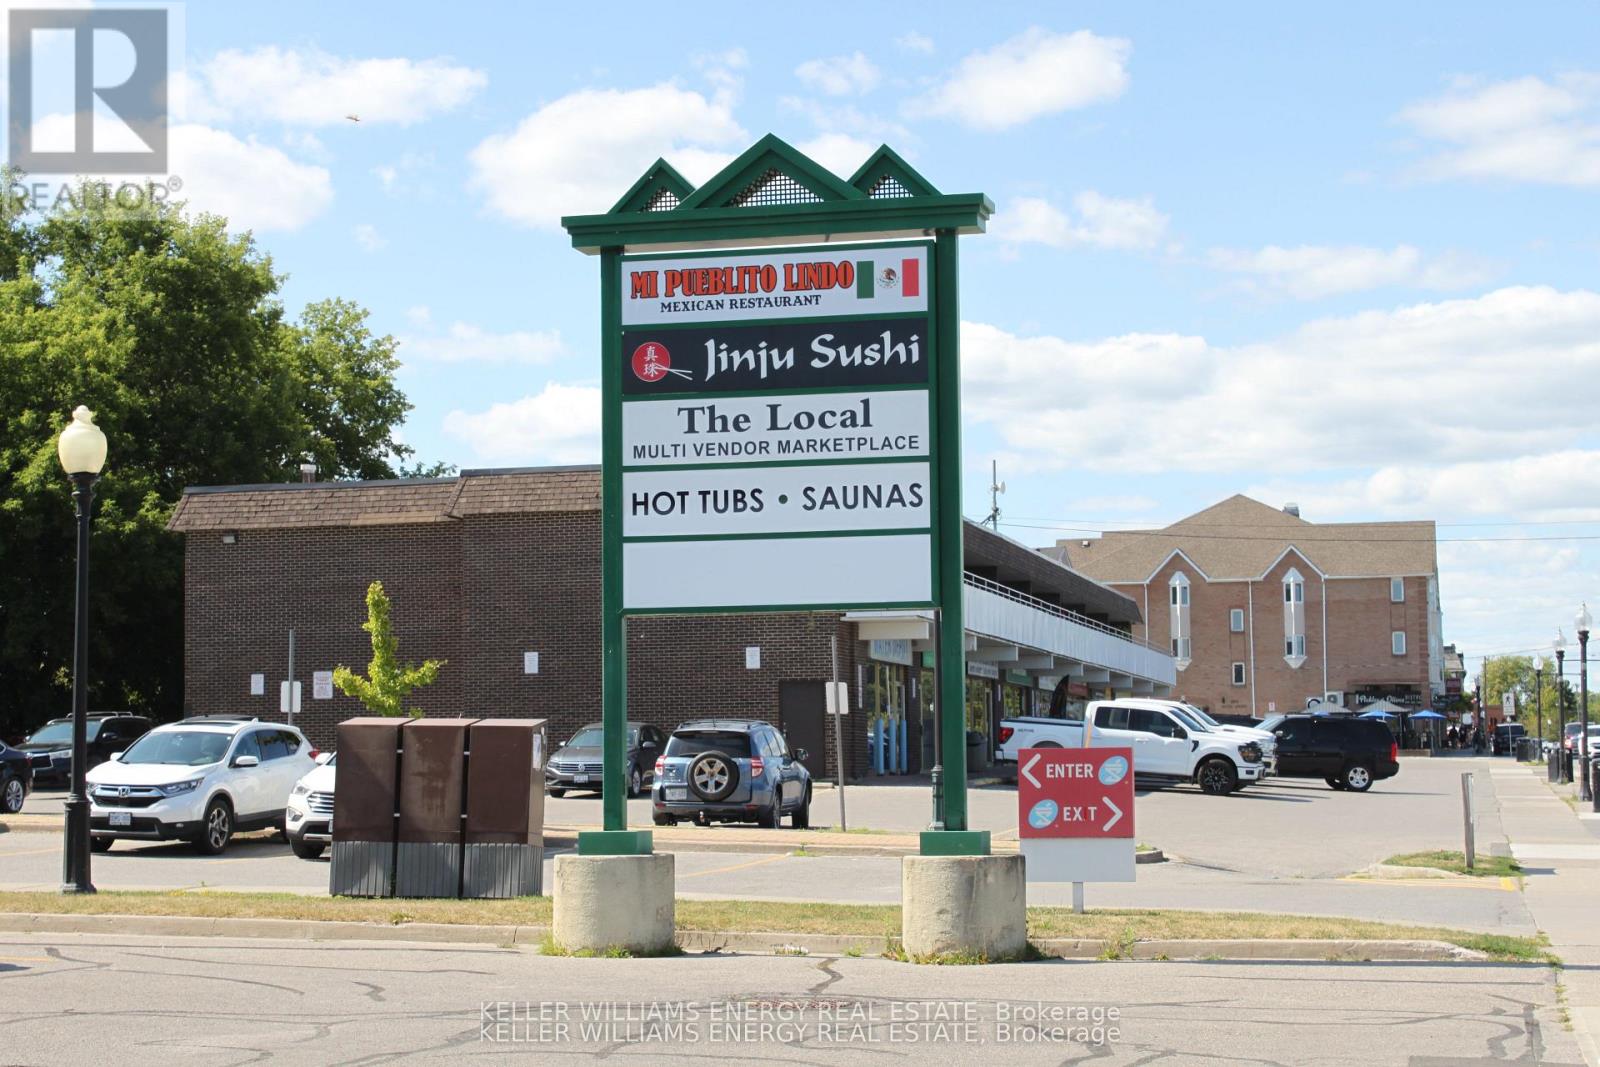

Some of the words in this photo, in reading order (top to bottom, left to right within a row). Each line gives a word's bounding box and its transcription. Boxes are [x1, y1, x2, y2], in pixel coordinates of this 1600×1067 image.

[631, 270, 659, 299] MI
[664, 264, 778, 297] PUEBLITO
[783, 260, 855, 292] LINDO
[660, 299, 725, 313] MEXICAN
[729, 295, 822, 309] RESTAURANT
[704, 338, 795, 382] Jinju
[810, 330, 920, 369] Sushi
[677, 404, 751, 434] The
[766, 398, 873, 431] Local
[633, 443, 686, 459] MULTI
[693, 440, 770, 457] VENDOR
[777, 435, 919, 454] MARKETPLACE
[632, 491, 689, 516] HOT
[698, 488, 764, 514] TUBS
[802, 482, 923, 511] SAUNAS
[1046, 763, 1094, 778] ENTER
